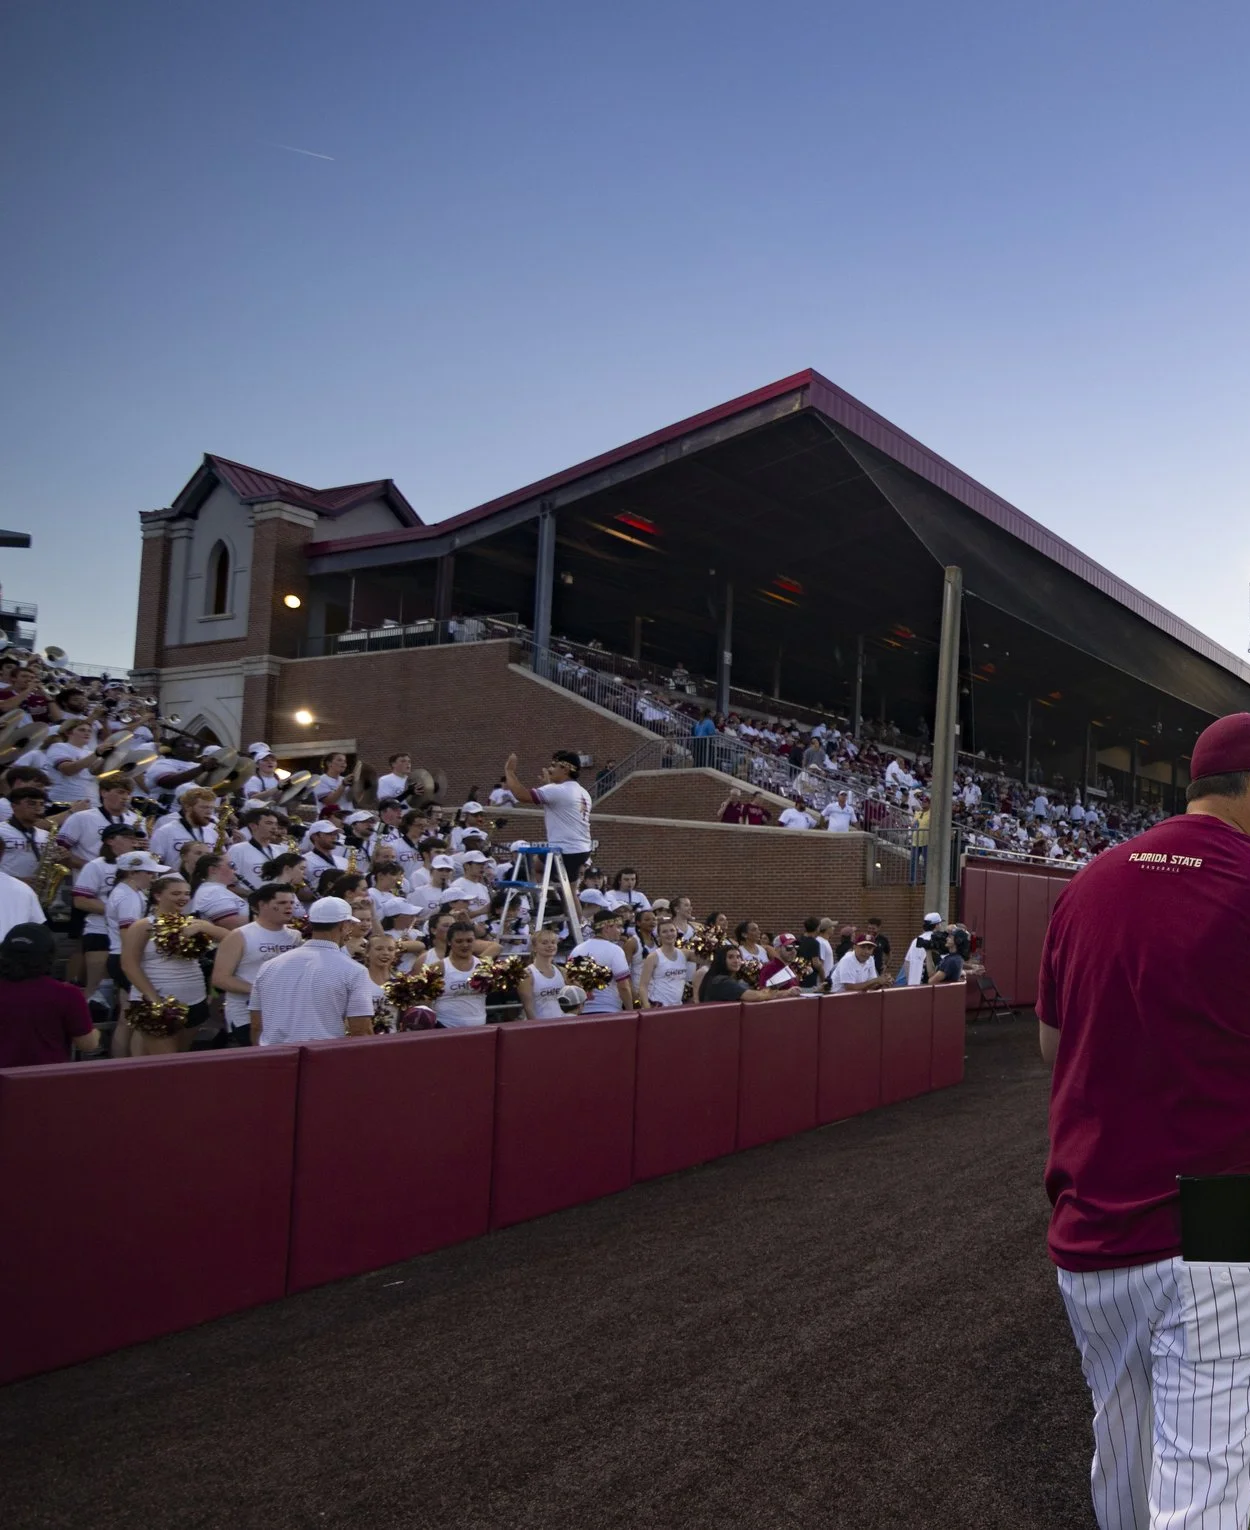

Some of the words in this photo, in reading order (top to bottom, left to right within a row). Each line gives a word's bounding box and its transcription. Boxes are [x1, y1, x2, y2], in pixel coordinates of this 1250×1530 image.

[1128, 852, 1168, 863] FLORIDA
[1170, 855, 1203, 868] STATE
[1140, 864, 1180, 873] BASEBALL
